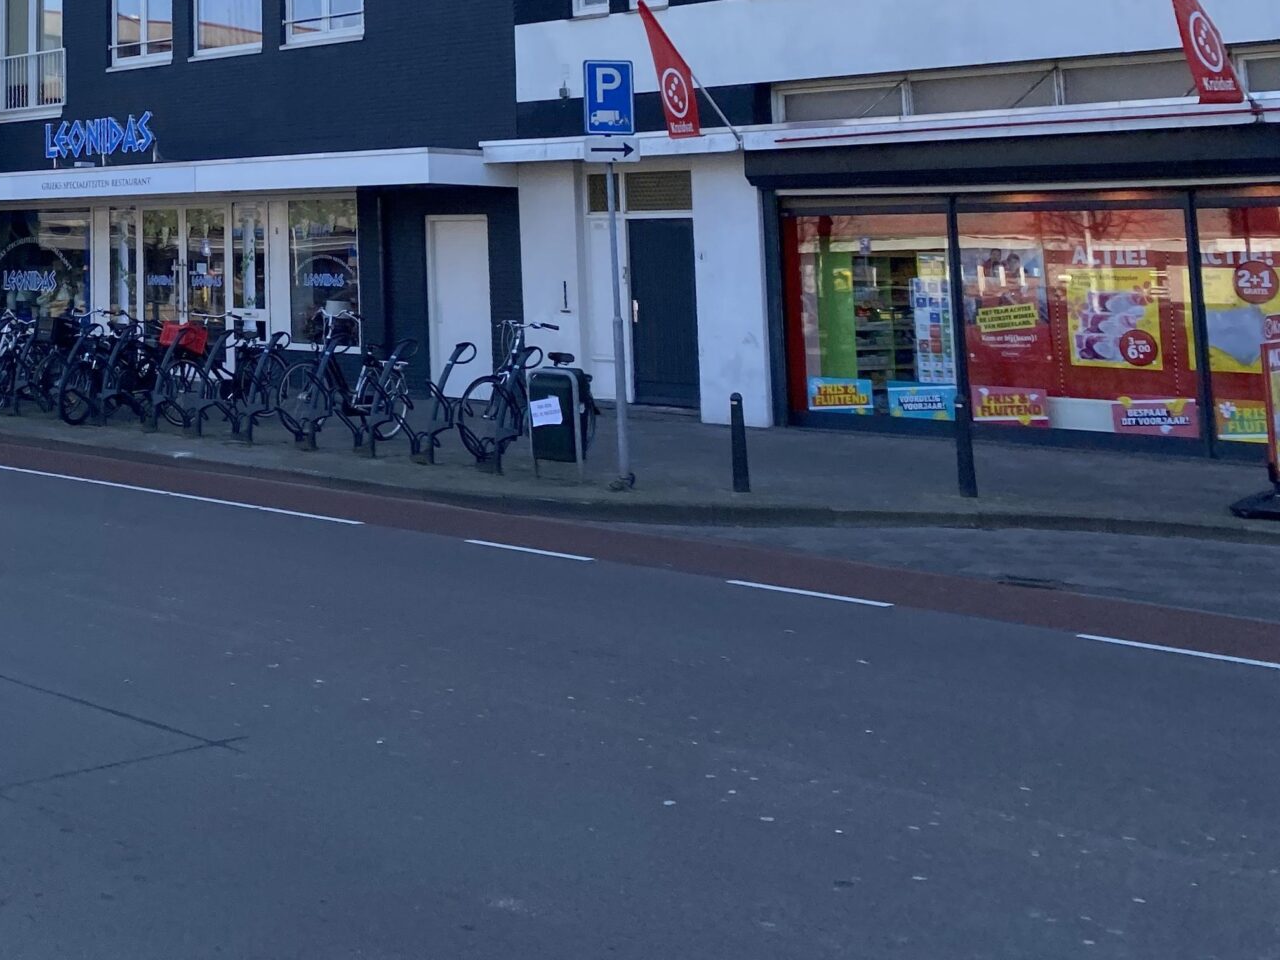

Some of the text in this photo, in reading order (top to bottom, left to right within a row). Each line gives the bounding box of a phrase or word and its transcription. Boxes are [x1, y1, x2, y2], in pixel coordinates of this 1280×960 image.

[595, 67, 622, 103] P
[45, 110, 154, 159] LEONIDAS
[111, 176, 151, 187] RESTAURANT
[1072, 245, 1148, 266] ACTIE!
[3, 270, 57, 292] LEONIDAS
[304, 273, 344, 287] LEONIDAS
[1237, 269, 1273, 288] 2+1
[820, 384, 856, 395] FRIS &
[815, 394, 868, 405] FLUITEND
[987, 394, 1029, 405] FRIS &
[981, 405, 1042, 416] FLUITEND
[1127, 408, 1167, 417] BESPAAR
[1122, 417, 1189, 426] DIT VOORJAAR!
